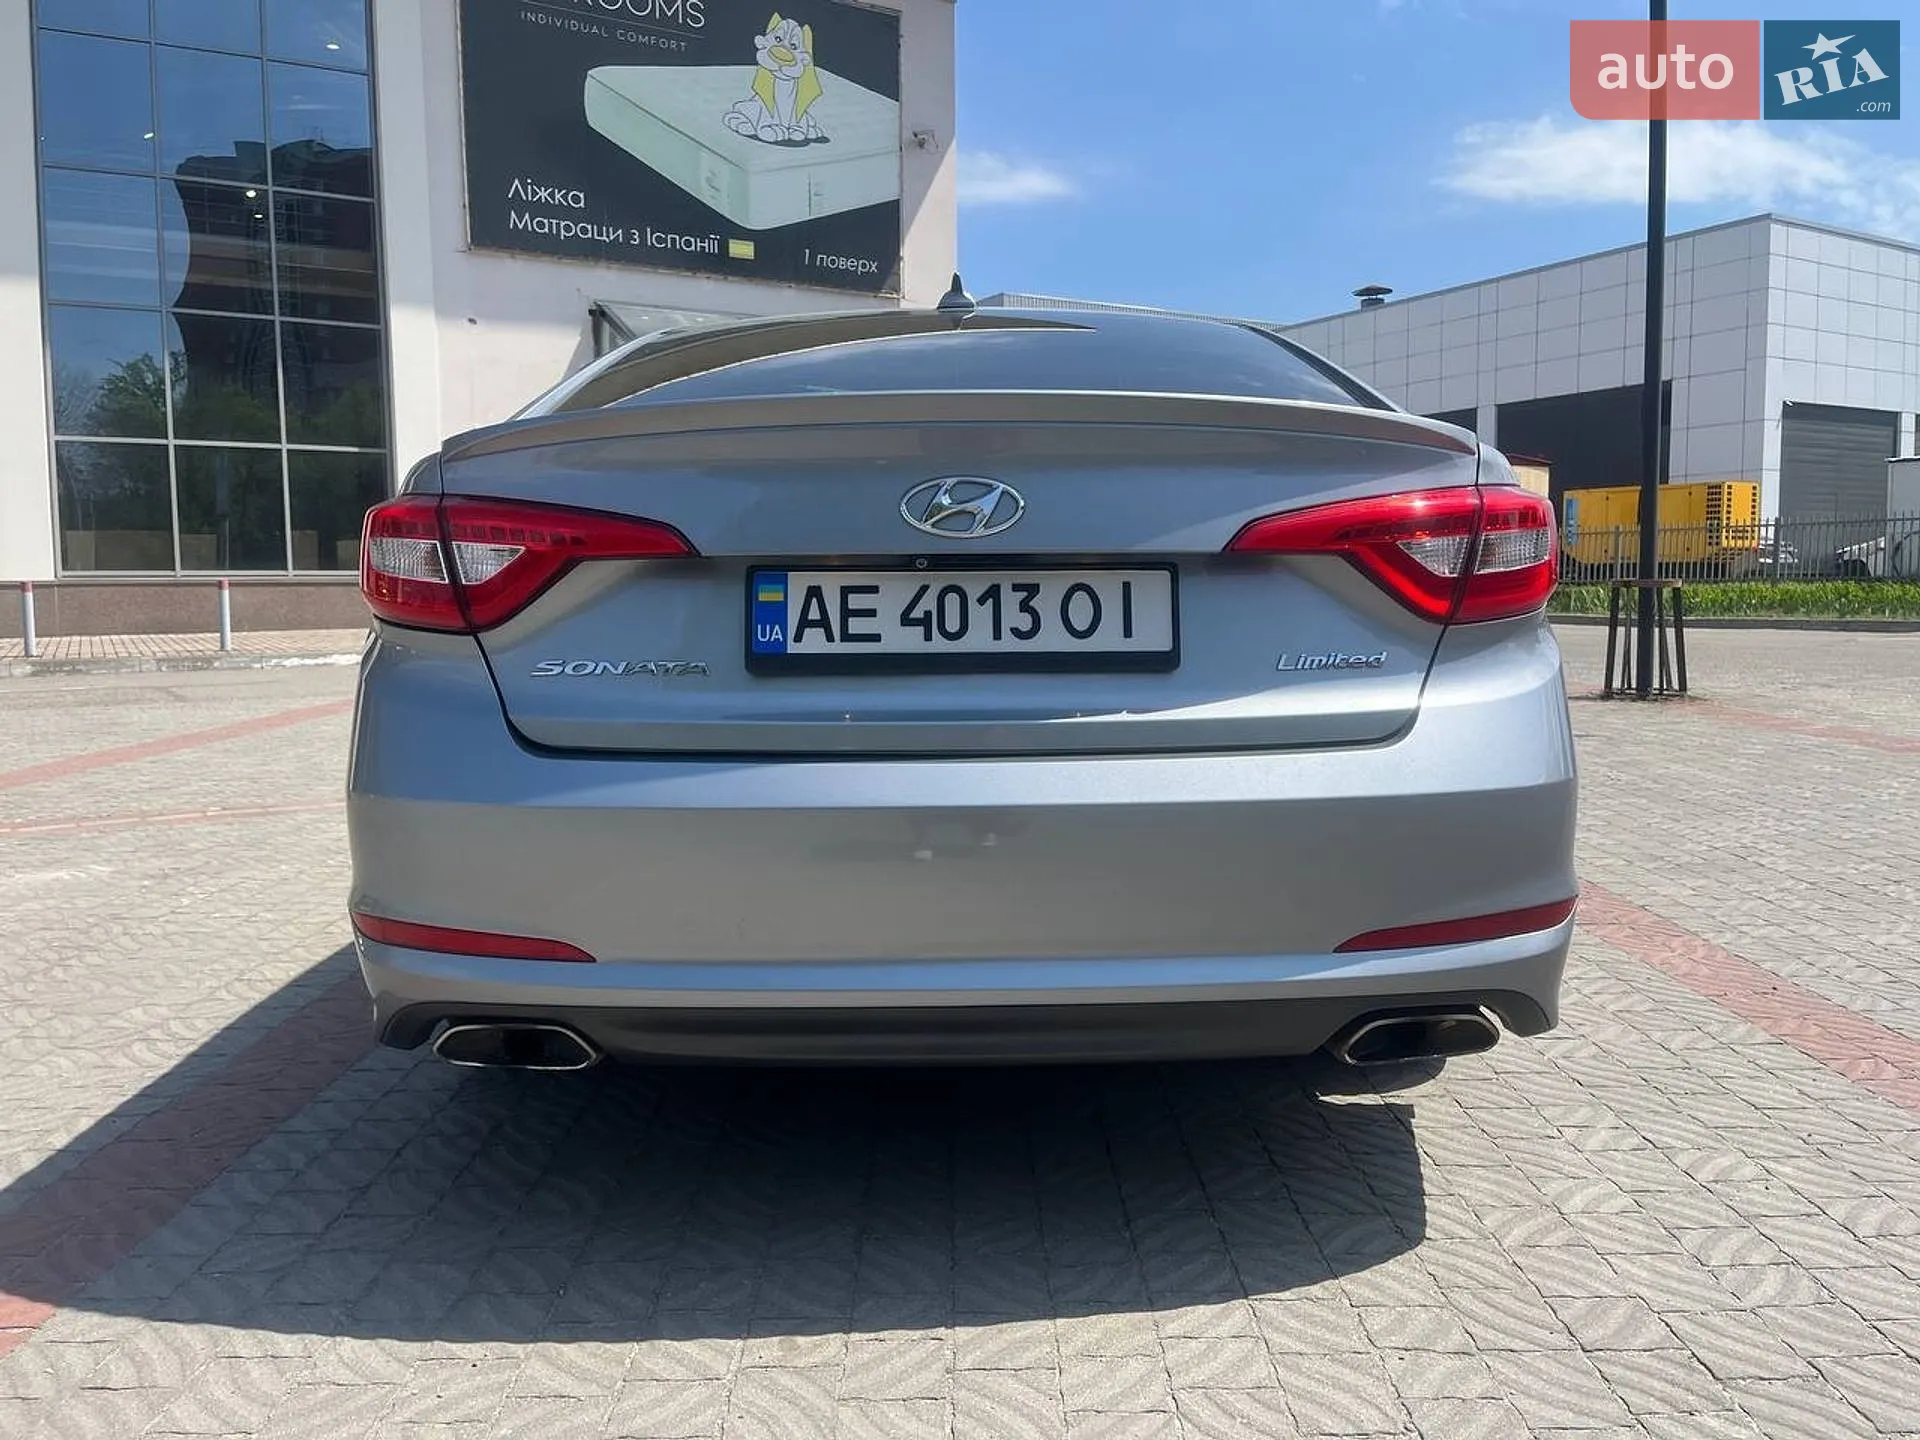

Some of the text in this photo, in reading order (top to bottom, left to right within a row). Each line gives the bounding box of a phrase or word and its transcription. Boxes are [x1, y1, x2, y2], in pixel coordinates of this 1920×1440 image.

[520, 10, 689, 52] INDIVIDUAL COMFORT
[507, 177, 585, 209] Ліжка
[509, 209, 721, 254] Матраци з Іспанії
[803, 249, 879, 276] 1 поверх
[793, 585, 882, 643] AE
[900, 582, 1042, 642] 4013
[757, 624, 783, 642] UA
[530, 659, 710, 677] SONATA
[1276, 651, 1389, 672] Limited
